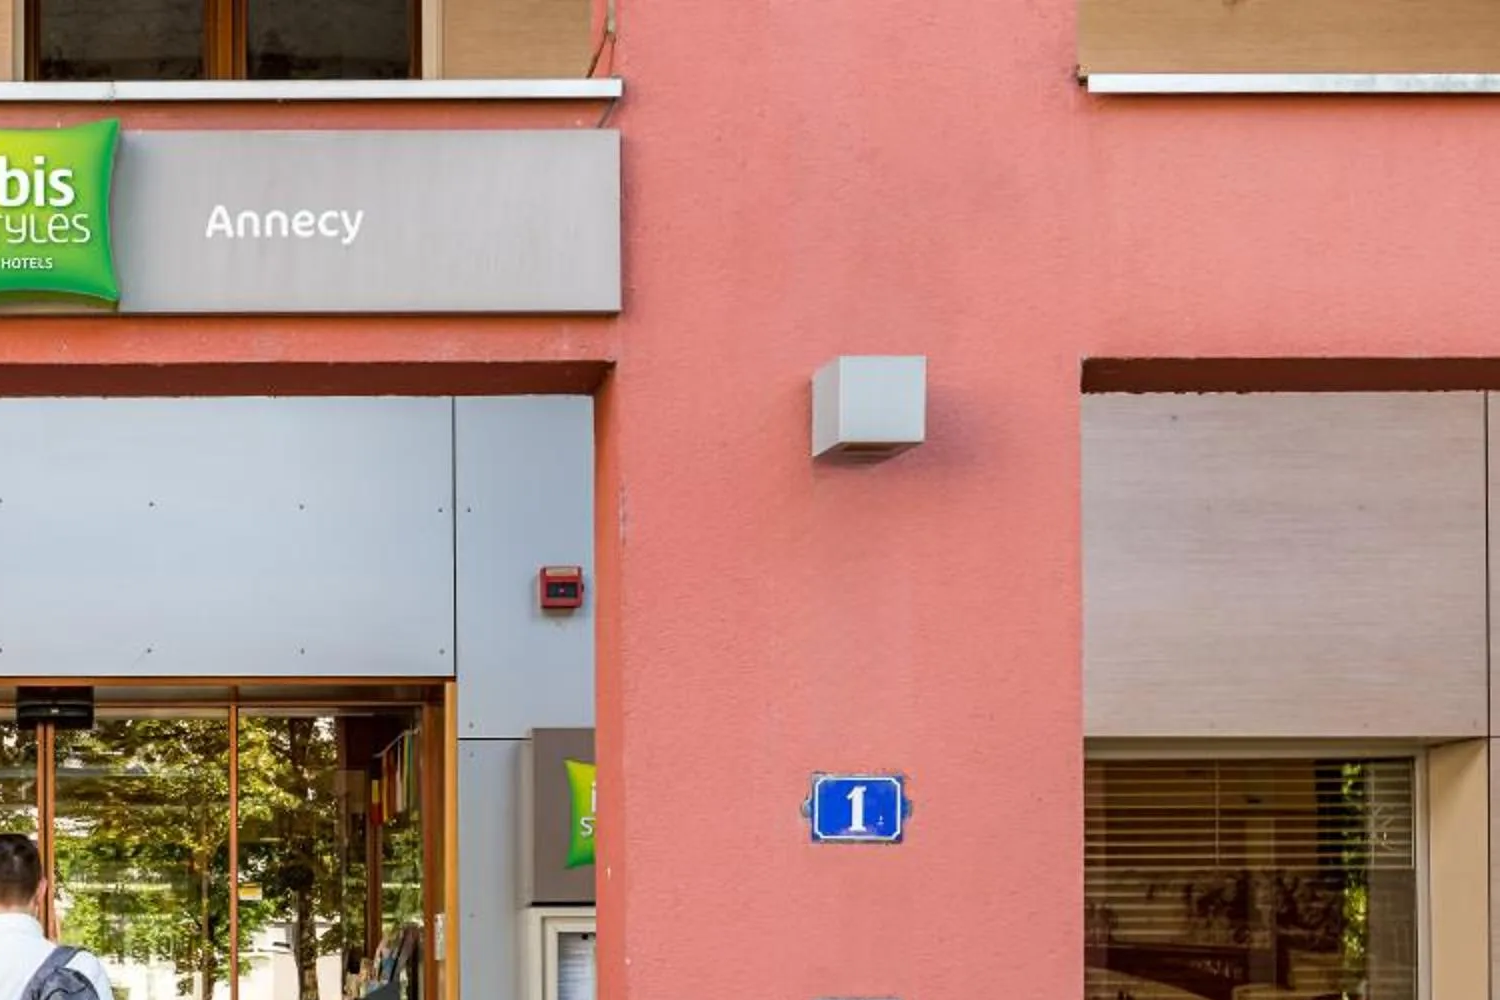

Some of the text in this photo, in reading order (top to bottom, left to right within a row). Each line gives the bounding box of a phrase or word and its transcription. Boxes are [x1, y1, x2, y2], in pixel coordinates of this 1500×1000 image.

[205, 204, 365, 246] Annecy
[0, 256, 54, 270] HOTELS
[845, 785, 867, 833] 1
